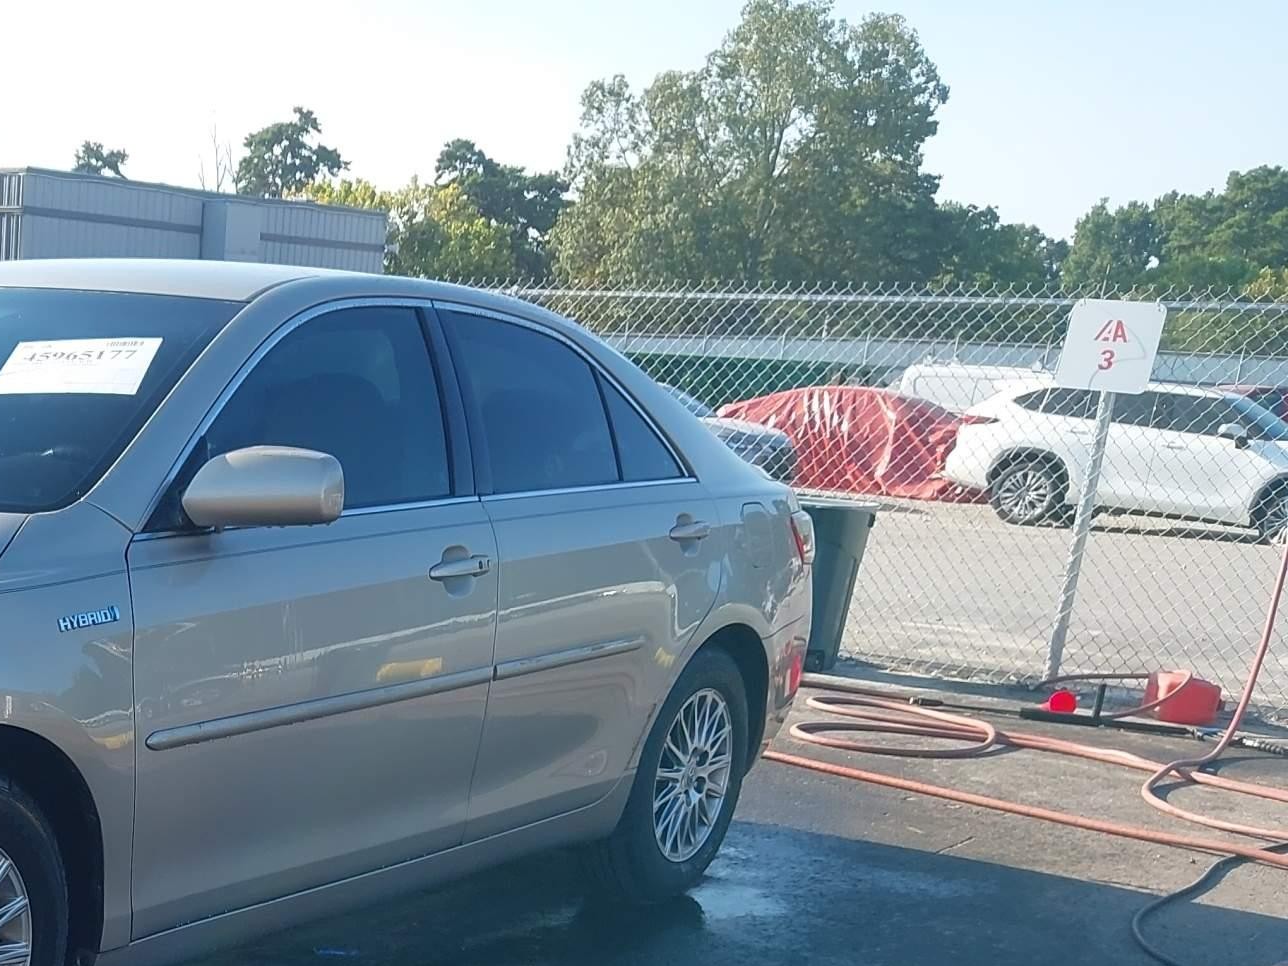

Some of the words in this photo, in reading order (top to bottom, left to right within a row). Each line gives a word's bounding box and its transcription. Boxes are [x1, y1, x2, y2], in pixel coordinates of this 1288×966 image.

[23, 349, 138, 362] 45965177
[1098, 349, 1115, 370] 3
[57, 608, 111, 632] HYBRID
